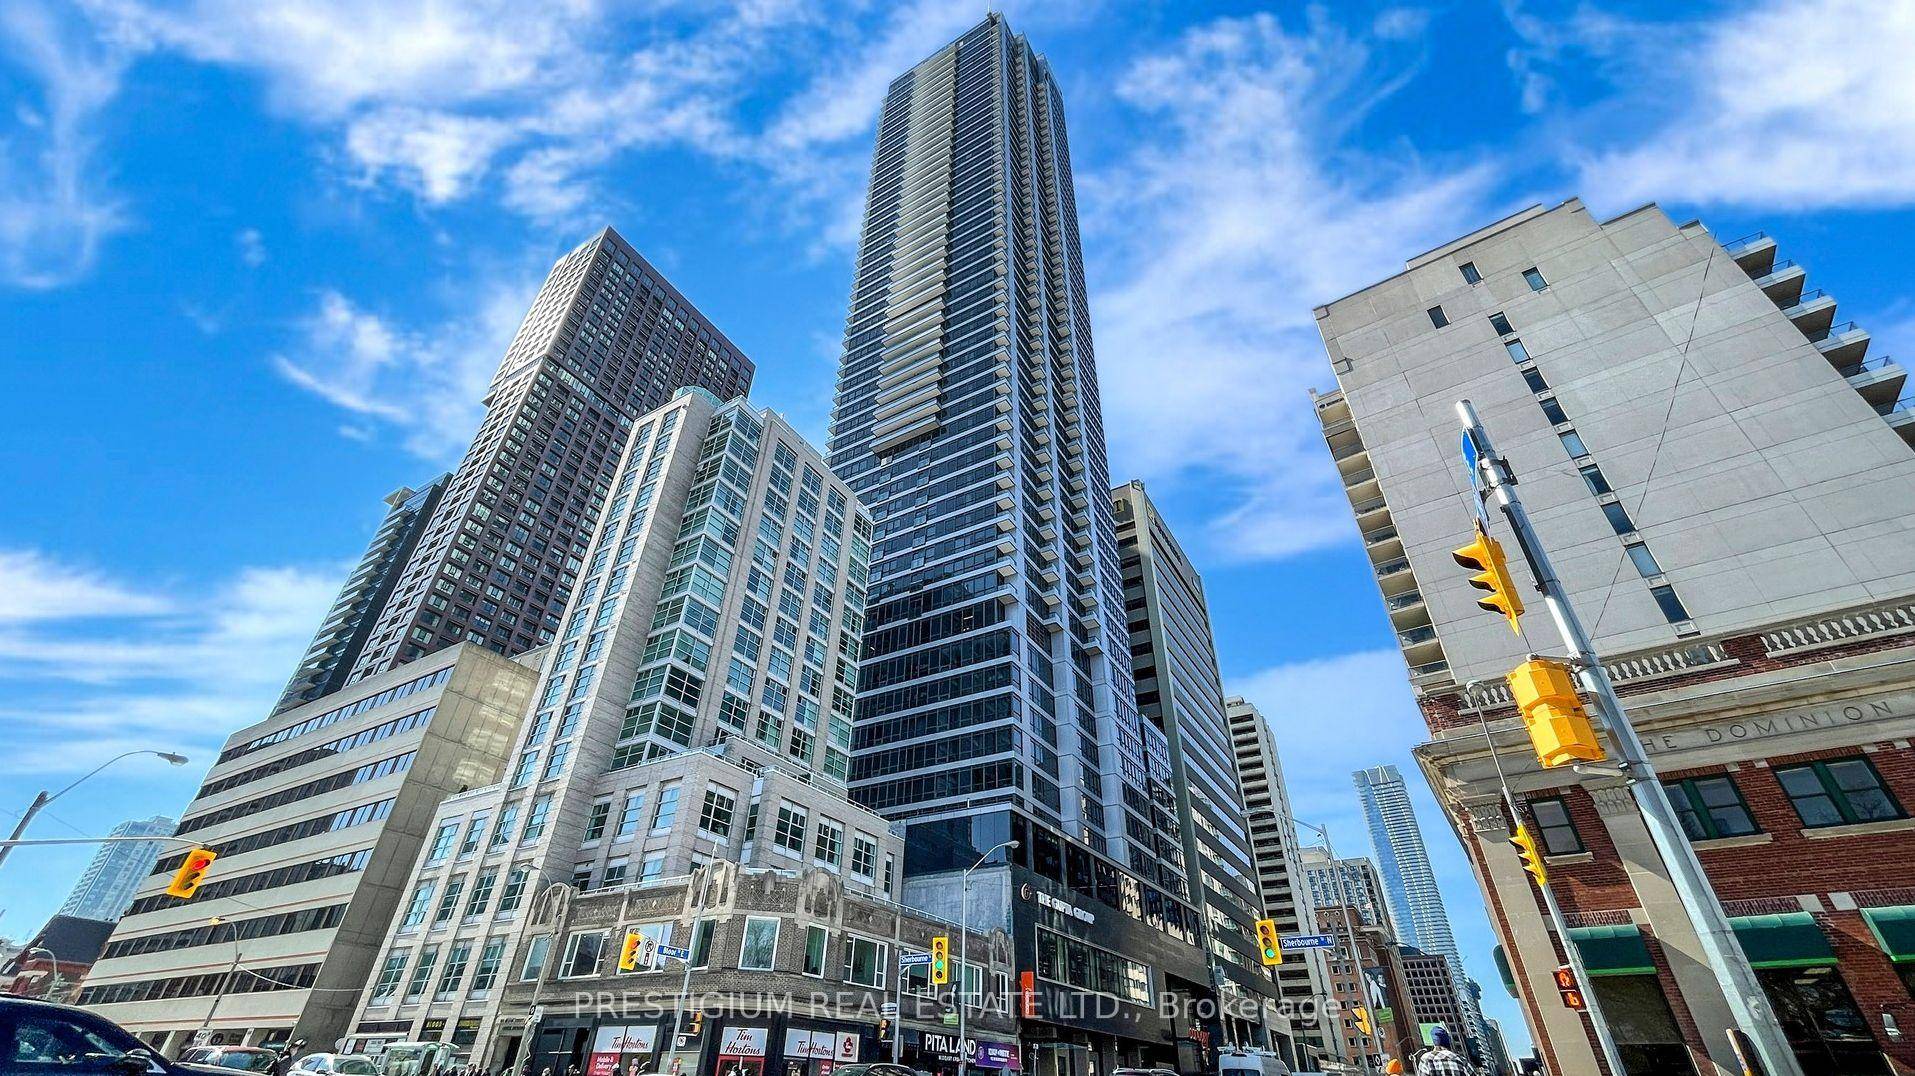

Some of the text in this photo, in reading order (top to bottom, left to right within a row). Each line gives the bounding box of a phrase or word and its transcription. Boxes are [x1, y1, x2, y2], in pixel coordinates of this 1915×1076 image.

[1642, 700, 1893, 751] HE DOMINION
[1283, 938, 1319, 948] Sherbourne
[1326, 936, 1333, 944] N
[901, 955, 929, 964] Sherbourne
[611, 1035, 649, 1050] Tim Hortons
[736, 1028, 753, 1042] Tim
[724, 1041, 761, 1056] Hortons
[796, 1040, 834, 1057] Tim Hortons
[925, 1033, 947, 1052] PITA
[950, 1036, 977, 1056] LAND
